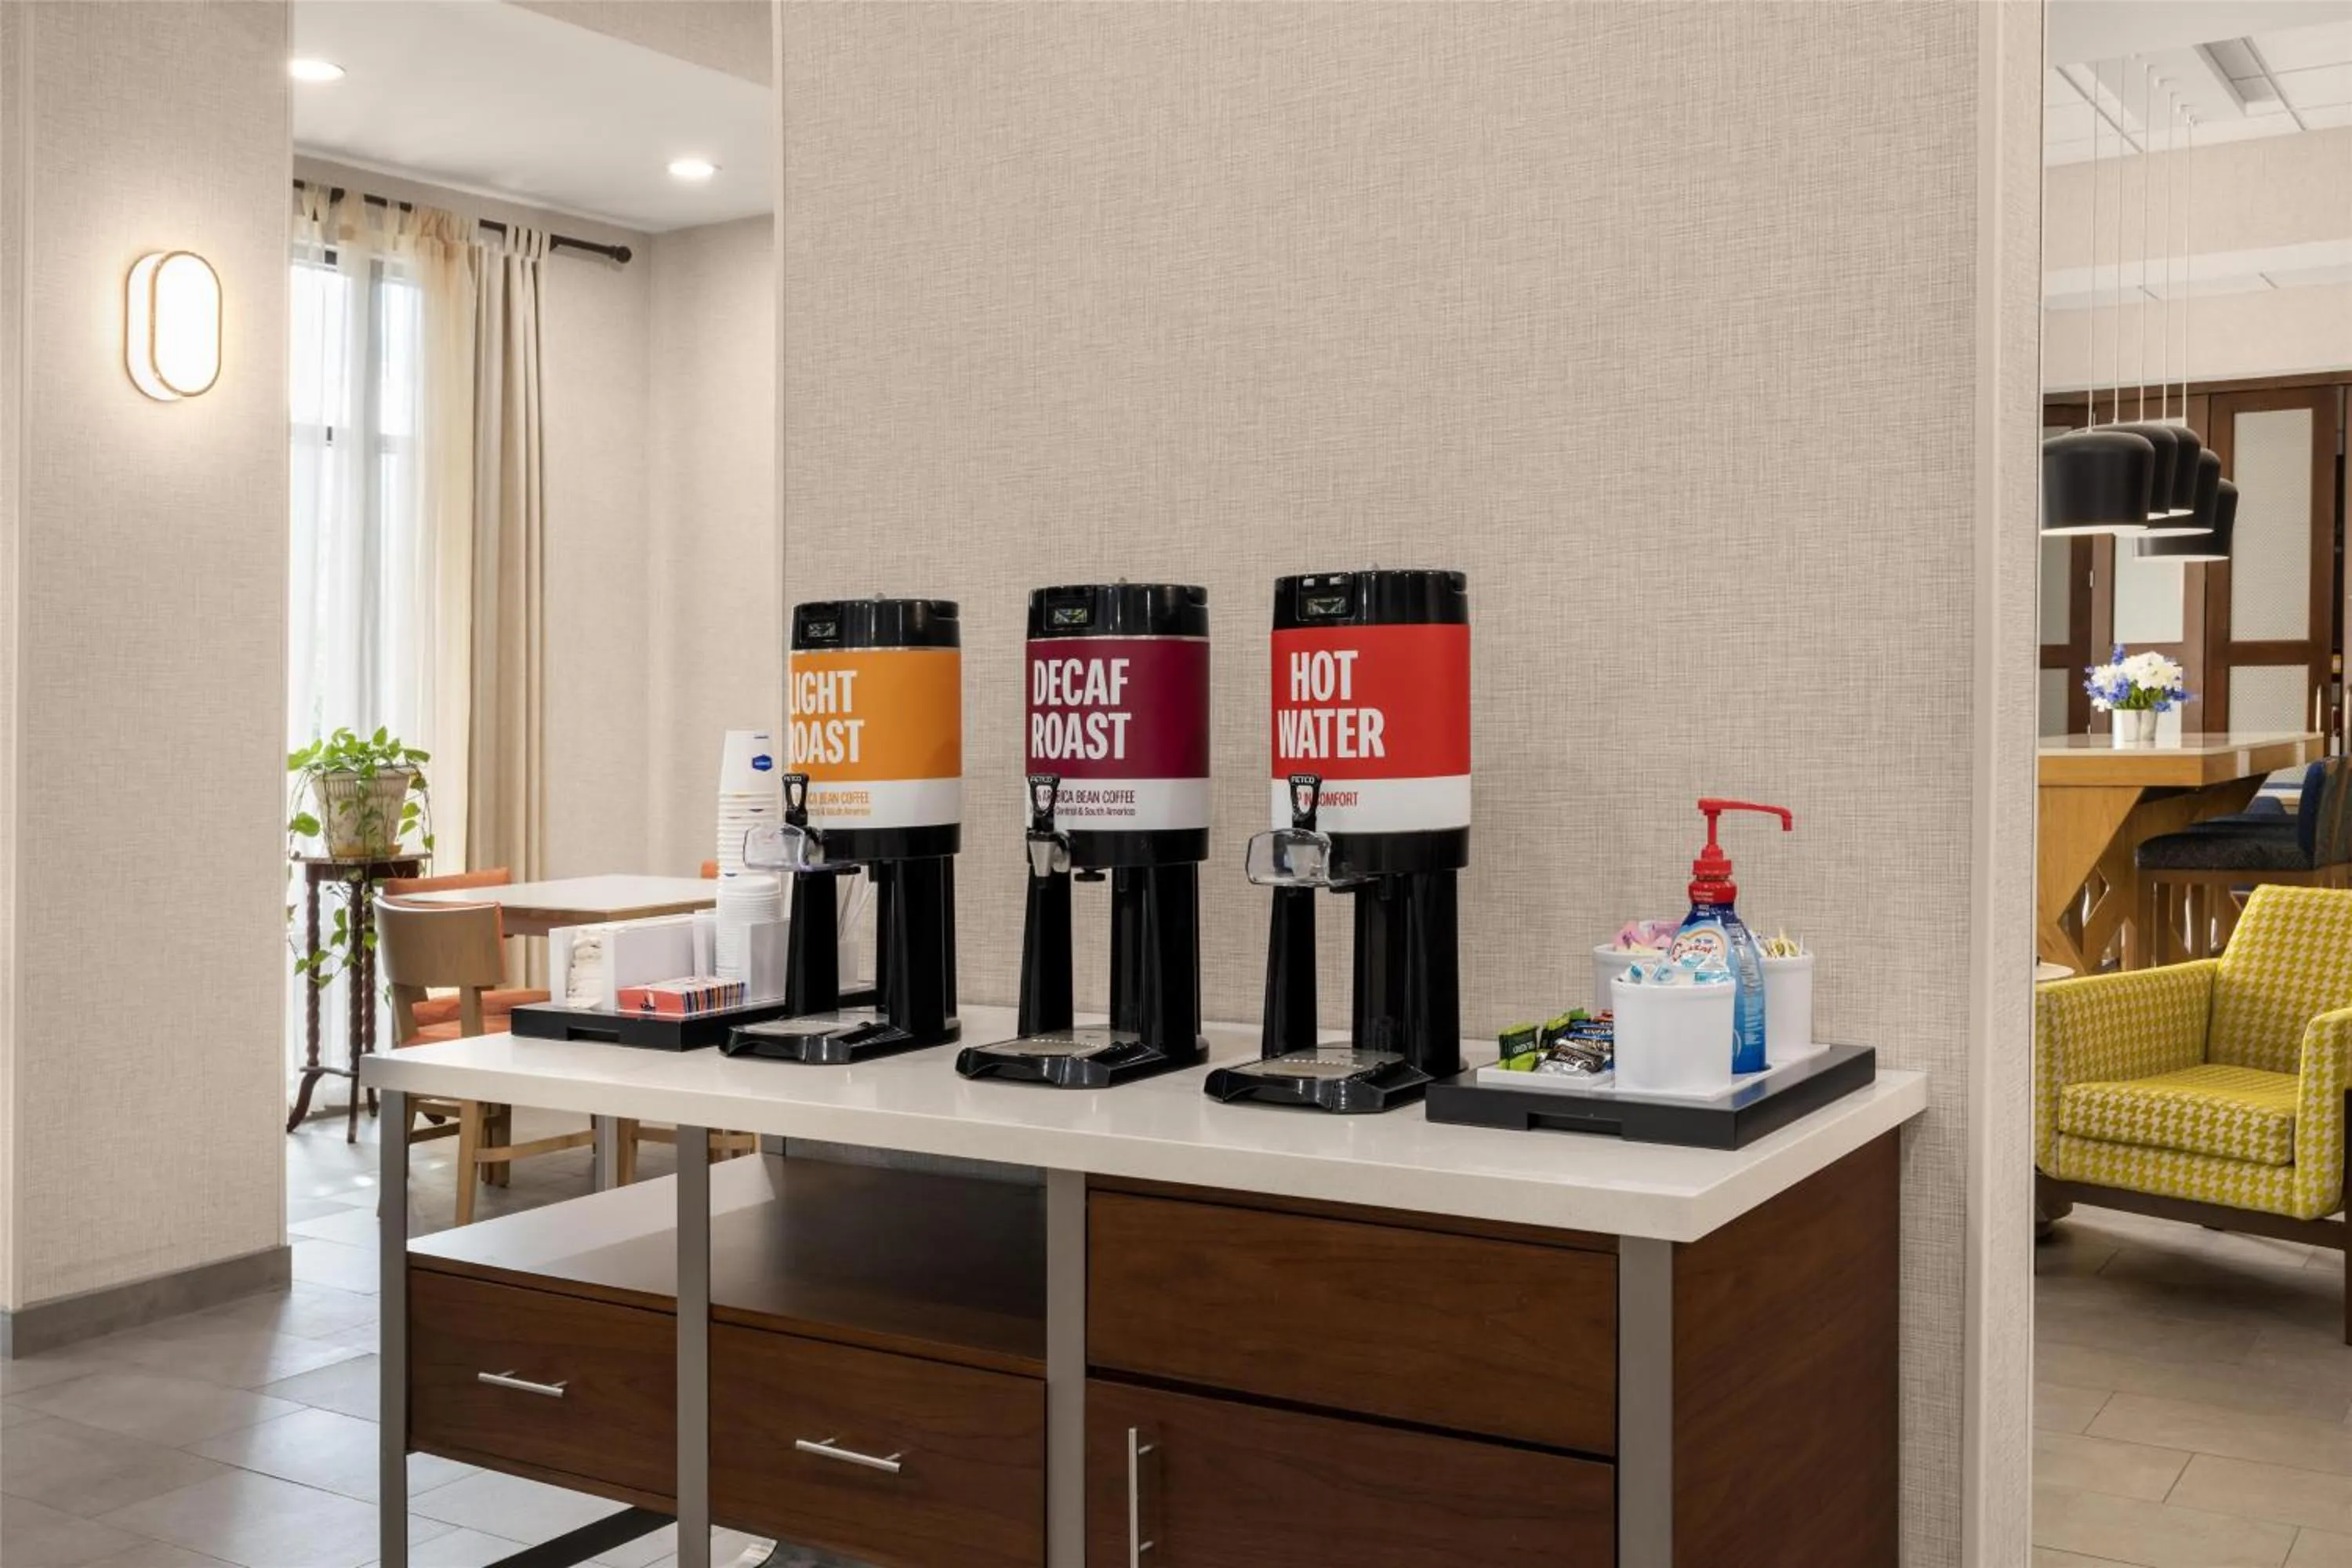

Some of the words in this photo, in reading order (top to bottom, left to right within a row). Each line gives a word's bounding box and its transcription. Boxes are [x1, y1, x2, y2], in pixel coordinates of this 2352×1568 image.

[1033, 659, 1130, 706] DECAF
[1290, 650, 1359, 702] HOT
[1031, 712, 1131, 760] ROAST
[1277, 708, 1385, 758] WATER
[841, 790, 869, 804] COFFEE
[1076, 790, 1100, 804] BEAN
[1102, 790, 1136, 804] COFFEE
[1078, 807, 1083, 816] &
[1084, 807, 1104, 816] South
[1319, 791, 1359, 806] OMFORT
